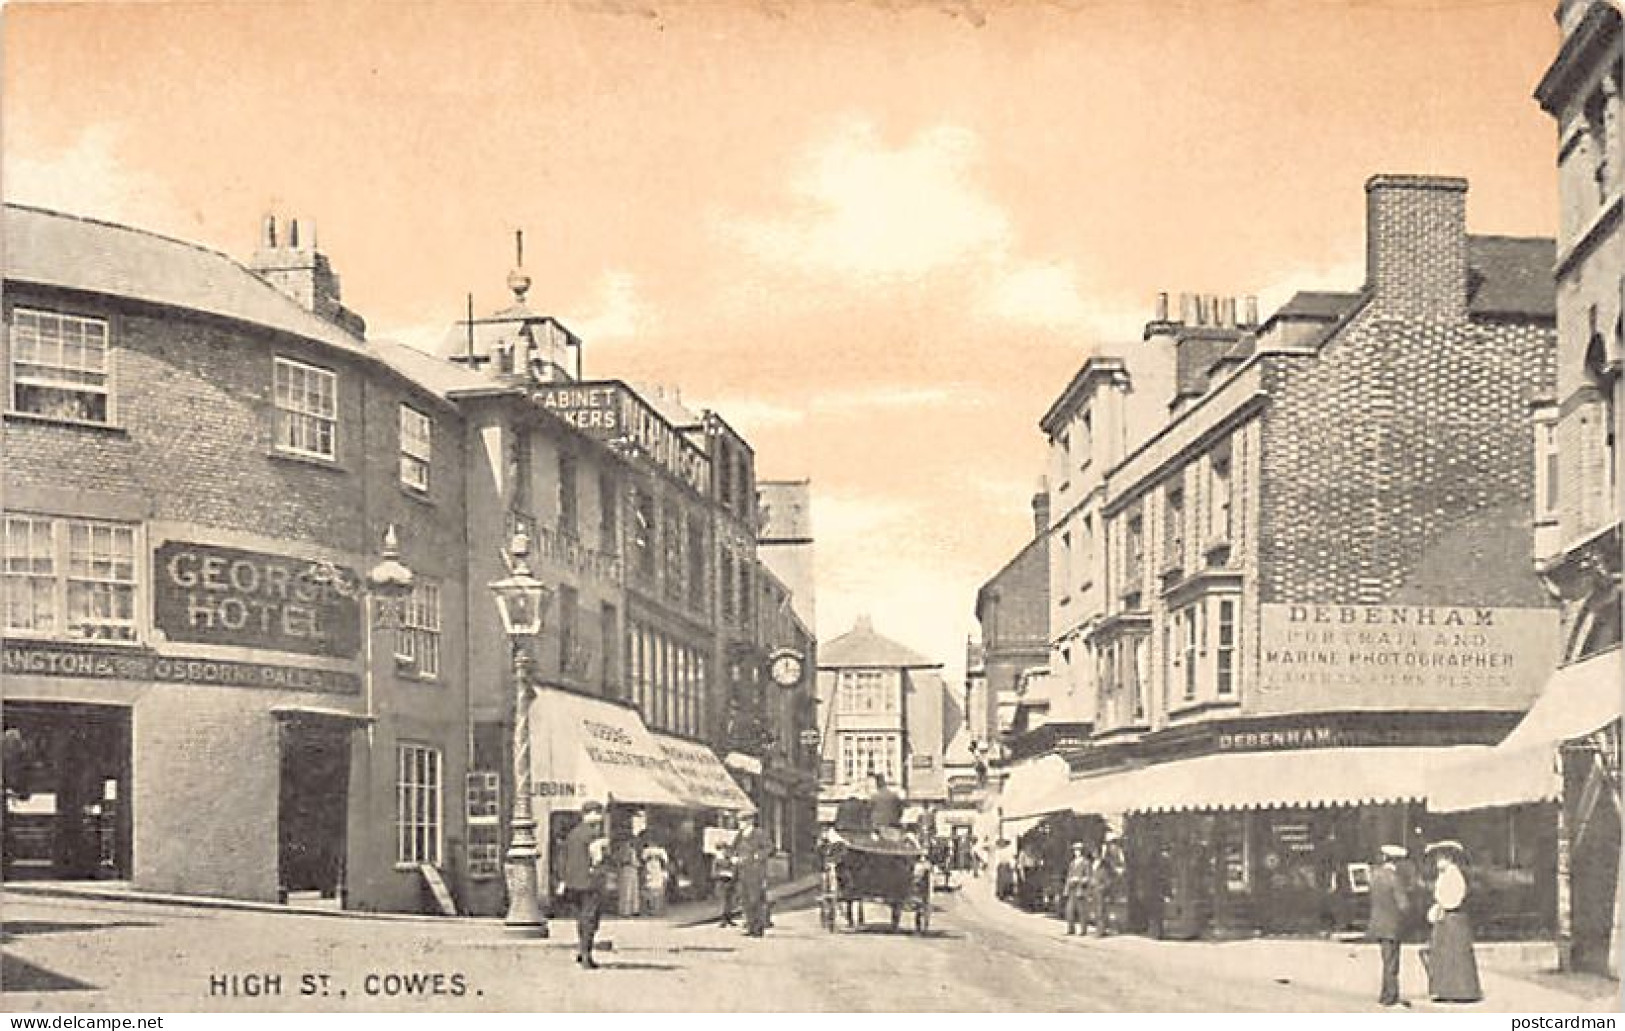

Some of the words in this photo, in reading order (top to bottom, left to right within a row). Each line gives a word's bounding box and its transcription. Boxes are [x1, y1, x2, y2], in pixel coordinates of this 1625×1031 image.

[187, 591, 325, 636] HOTEL
[1289, 606, 1494, 626] DEBENHAM
[1434, 633, 1487, 647] AND
[1266, 651, 1339, 665] MARINE
[1349, 652, 1513, 668] PHOTOGRAPHER
[1219, 727, 1330, 748] DEBENHAM
